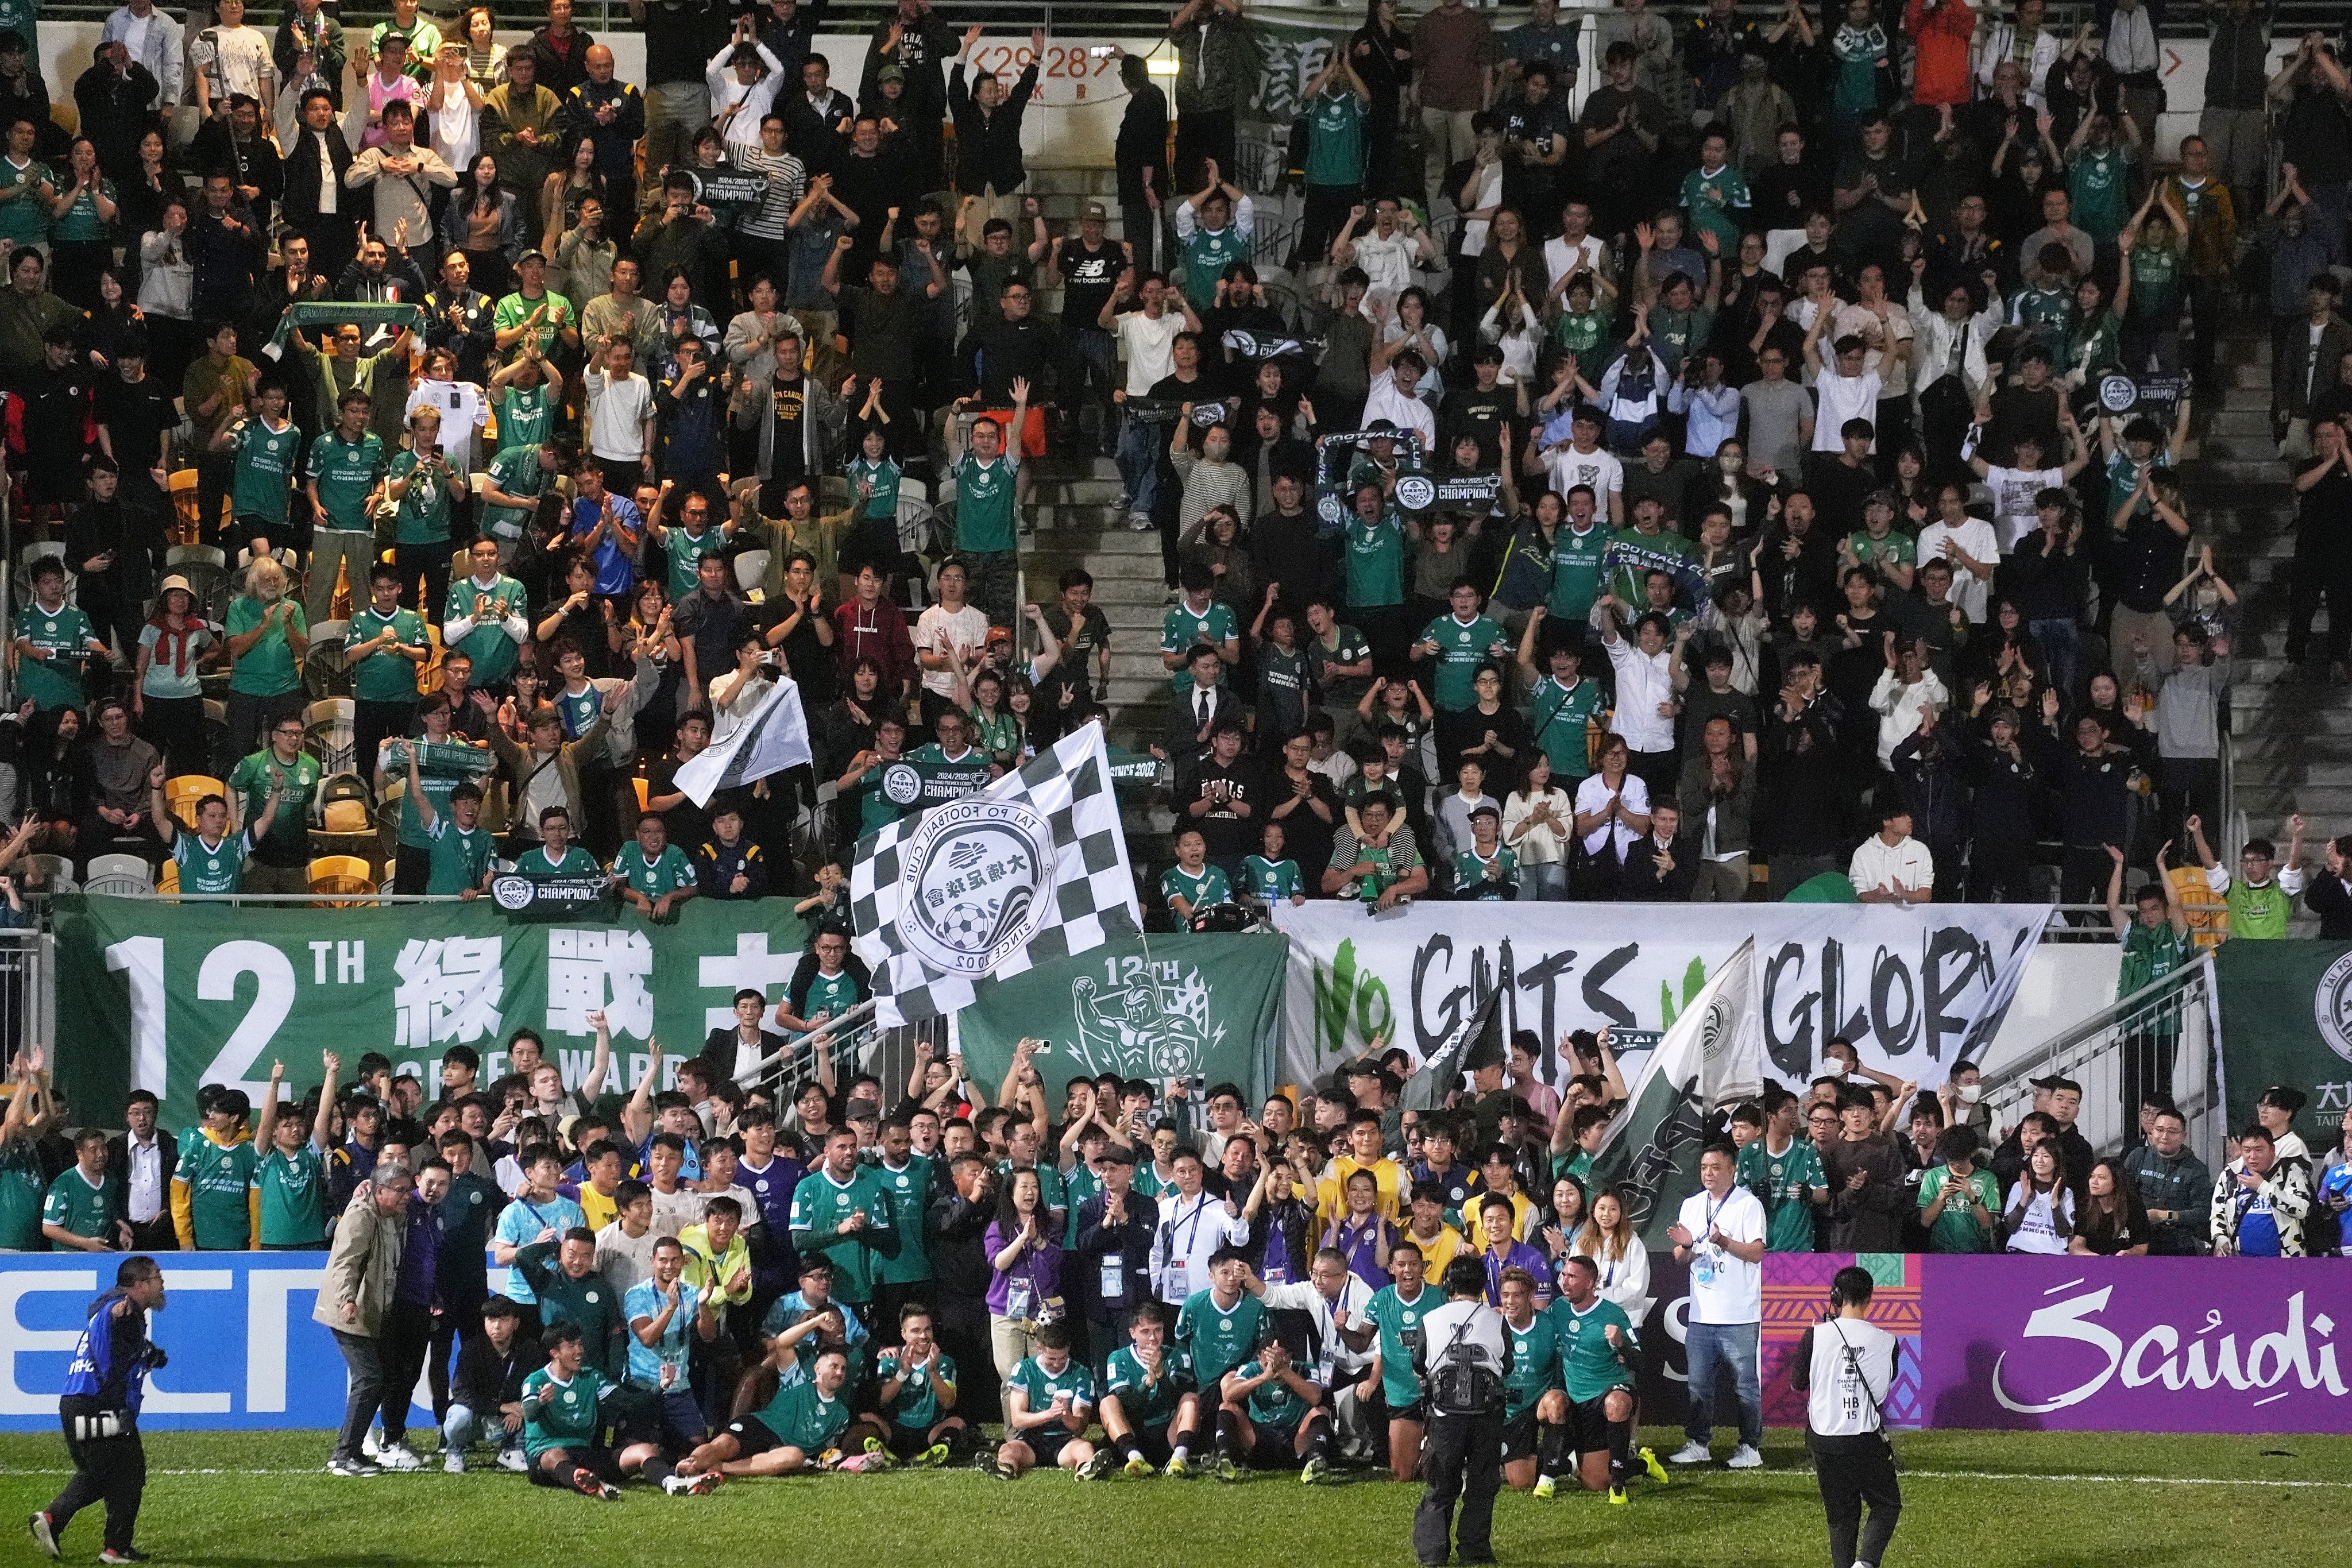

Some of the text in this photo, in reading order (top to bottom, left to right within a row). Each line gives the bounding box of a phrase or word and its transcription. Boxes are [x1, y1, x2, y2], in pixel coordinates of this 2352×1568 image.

[1046, 46, 1088, 77] 28
[997, 83, 1044, 100] BLK
[706, 189, 754, 202] CHAMPION
[1324, 430, 1405, 447] FOOTBALL
[1409, 435, 1421, 469] CLUB
[1438, 488, 1489, 500] CHAMPION
[1612, 542, 1683, 568] FOOTBALL
[1110, 761, 1157, 777] SINCE 2002
[937, 772, 970, 781] 2024/2025
[924, 785, 974, 798] CHAMPION
[538, 887, 591, 900] CHAMPION
[1104, 956, 1180, 987] 12TH
[2324, 973, 2339, 988] TAI
[106, 936, 365, 1109] 12TH
[1622, 1034, 1651, 1042] TAI
[2315, 1115, 2343, 1126] TAIP
[1992, 1278, 2350, 1413] Saudi
[1843, 1397, 1859, 1409] HB
[1846, 1411, 1857, 1420] 15
